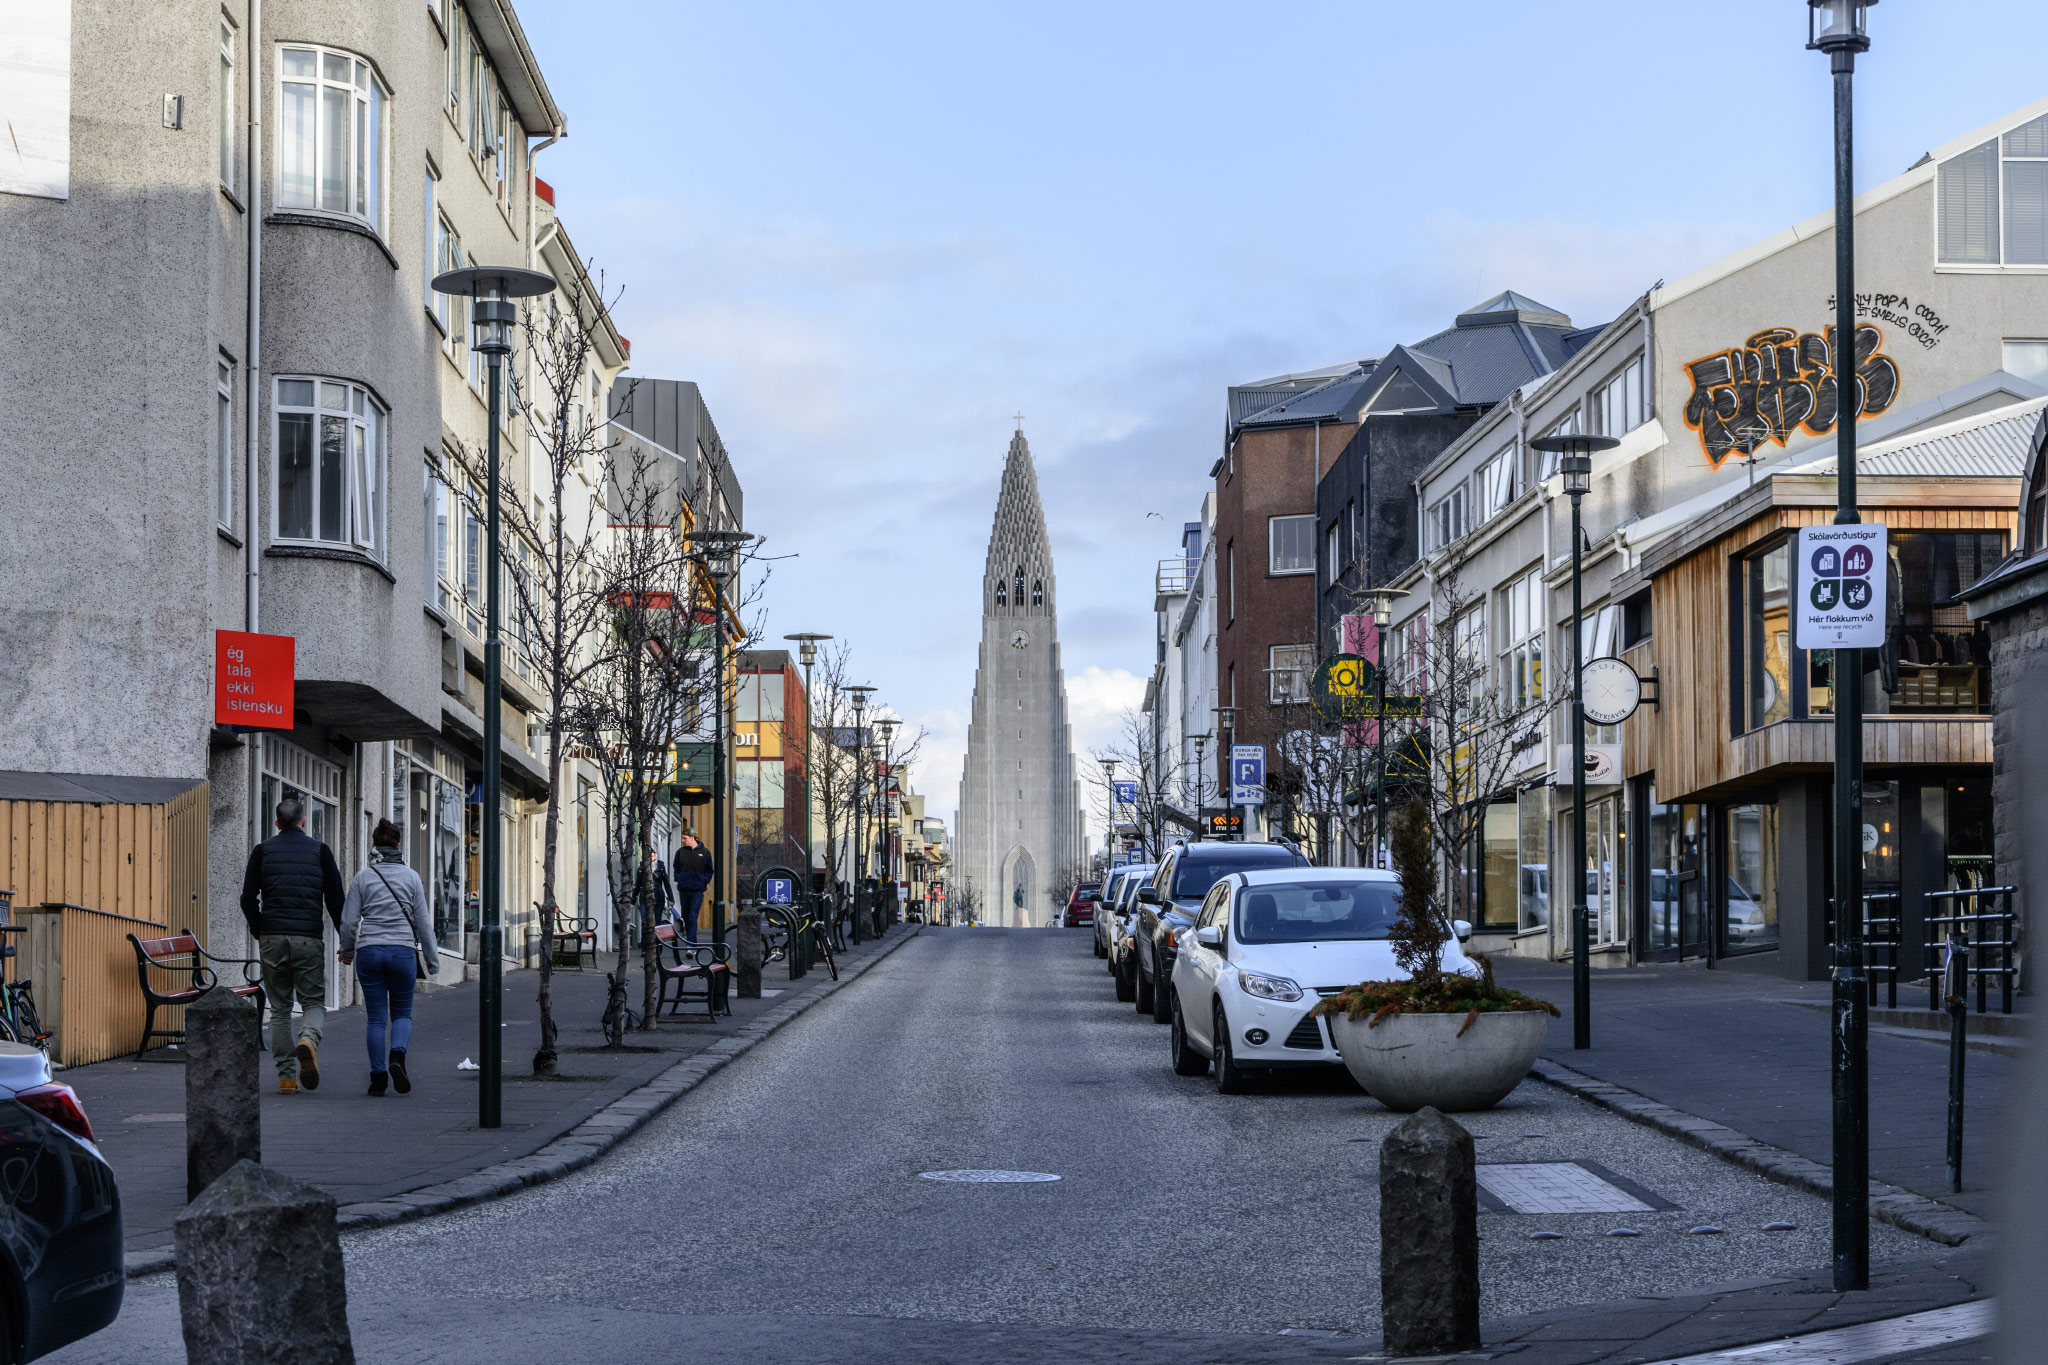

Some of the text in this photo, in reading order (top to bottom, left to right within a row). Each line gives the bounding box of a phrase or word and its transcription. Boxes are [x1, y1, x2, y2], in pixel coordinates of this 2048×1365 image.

[1854, 293, 1871, 307] NLY
[1875, 293, 1899, 308] POP
[1898, 297, 1909, 310] A
[1856, 306, 1871, 317] IT
[1871, 307, 1909, 328] SMELLS
[1808, 531, 1878, 541] Skólavörðustígur
[1808, 613, 1874, 623] Hér flokkum við
[1842, 623, 1863, 631] recycle
[227, 645, 244, 662] ég
[227, 663, 251, 677] tala
[1590, 664, 1625, 677] SUIT
[226, 680, 255, 695] ekki
[1241, 763, 1254, 781] P
[775, 880, 785, 893] P
